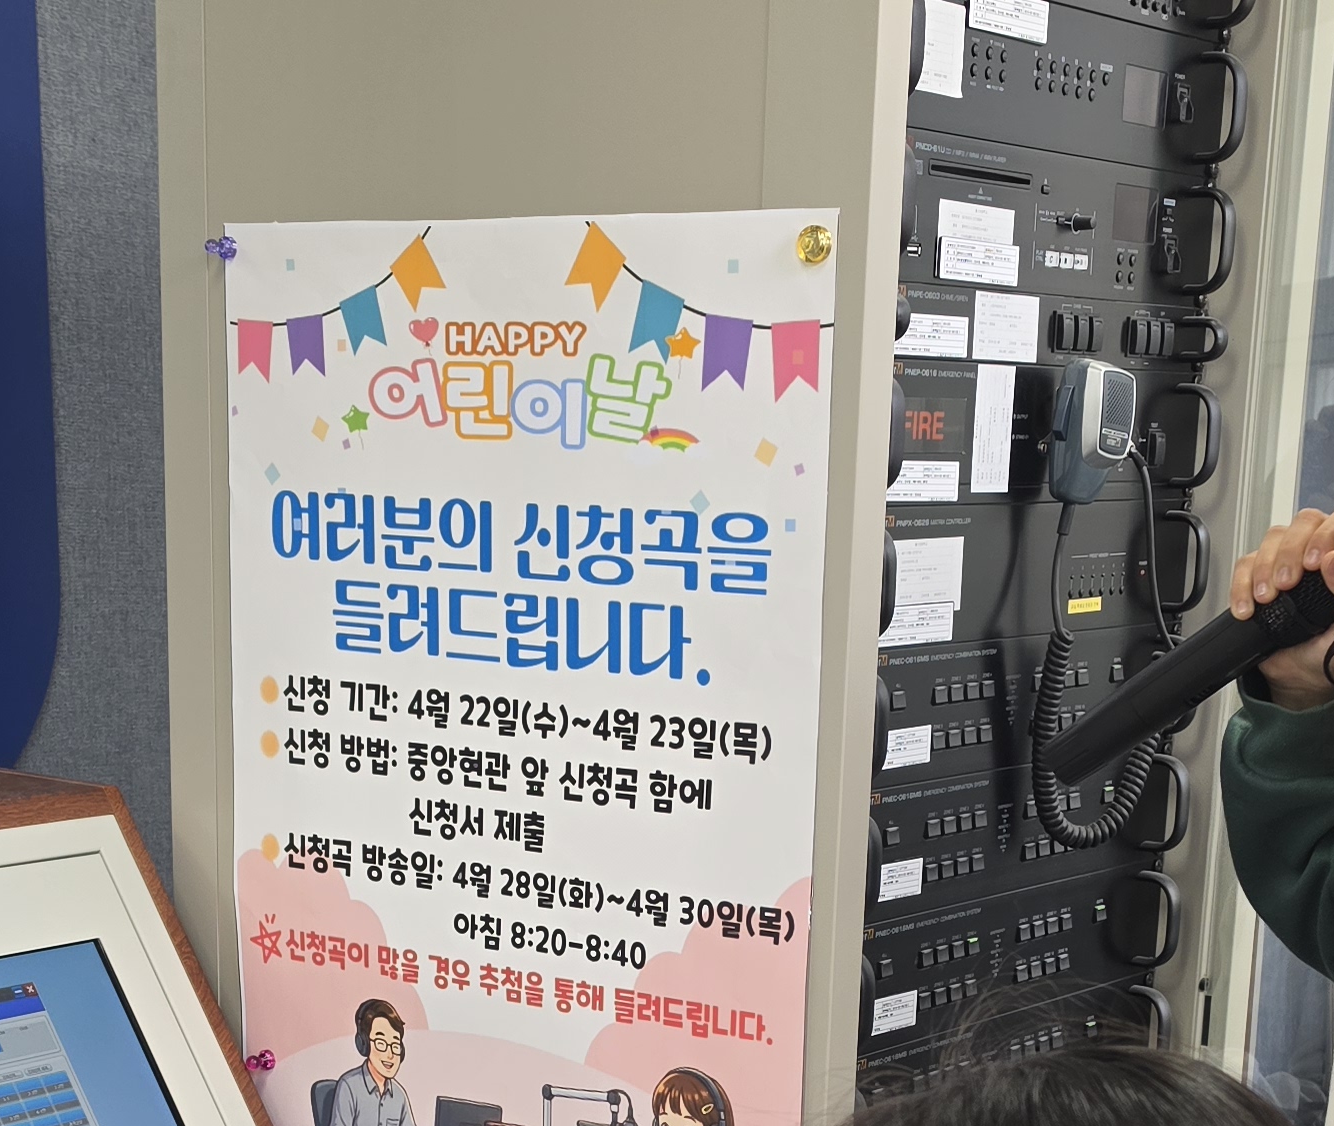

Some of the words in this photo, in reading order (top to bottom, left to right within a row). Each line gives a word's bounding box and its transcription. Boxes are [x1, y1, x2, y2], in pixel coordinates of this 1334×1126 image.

[444, 319, 587, 358] HAPPY
[367, 353, 673, 450] 어린이날
[905, 410, 945, 441] FIRE
[272, 489, 495, 574] 여러분의
[512, 501, 773, 596] 신청곡을
[332, 578, 712, 687] 들려드립니다.
[283, 675, 332, 715] 신청
[340, 680, 399, 719] 기간:
[406, 688, 451, 729] 4월
[459, 693, 641, 752] 22일(수)~4월
[649, 713, 773, 764] 23일(목)
[283, 727, 332, 769] 신청
[339, 736, 398, 774] 방법:
[406, 743, 511, 793] 중앙현관
[520, 756, 550, 797] 앞
[558, 761, 639, 811] 신청곡
[648, 771, 714, 815] 함에
[408, 797, 484, 837] 신청서
[494, 808, 547, 854] 제출
[283, 832, 353, 876] 신청곡
[361, 845, 445, 890] 방송일:
[452, 862, 492, 900] 4월
[499, 866, 670, 927] 28일(화)~4월
[679, 895, 796, 946] 30일(목)
[452, 912, 502, 951] 아침
[510, 922, 647, 970] 8:20-8:40
[285, 928, 370, 971] 신청곡이
[376, 947, 420, 984] 많을
[427, 953, 471, 991] 경우
[479, 963, 544, 1008] 추첨을
[553, 977, 605, 1014] 통해
[613, 988, 775, 1046] 들려드립니다.
